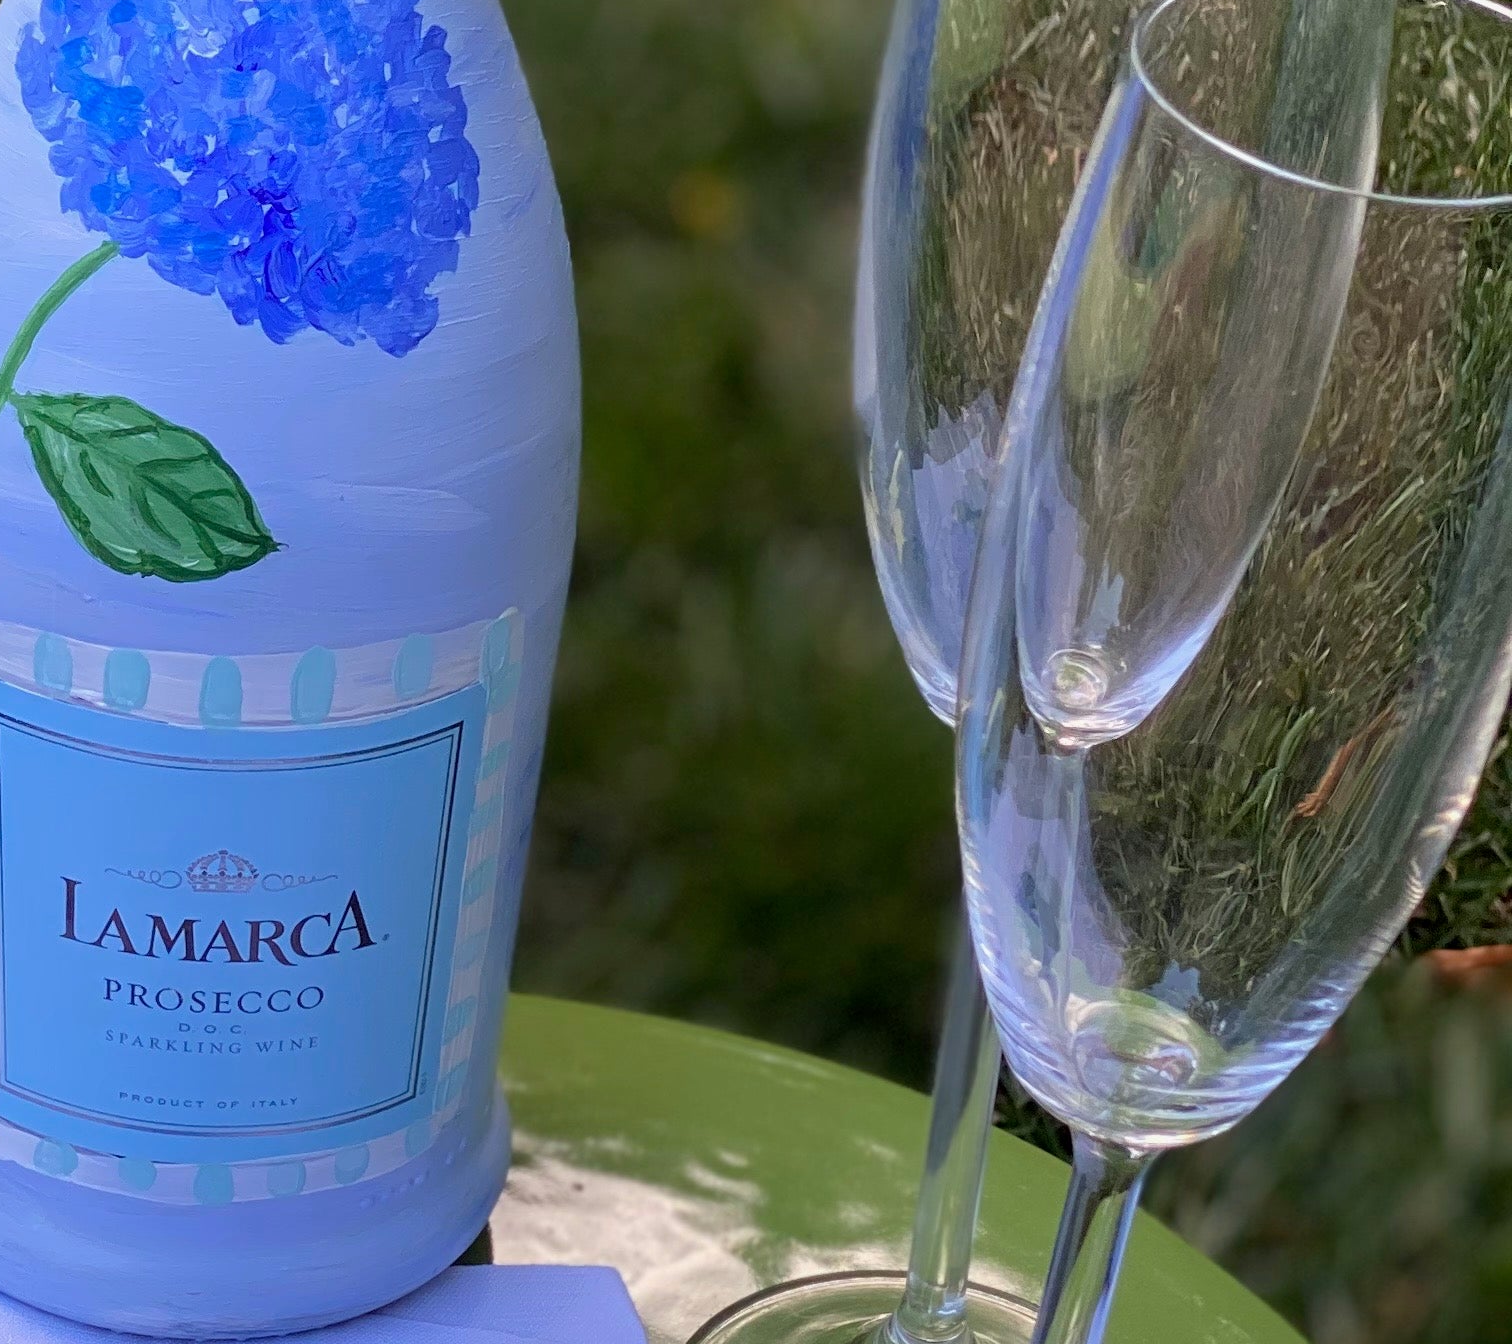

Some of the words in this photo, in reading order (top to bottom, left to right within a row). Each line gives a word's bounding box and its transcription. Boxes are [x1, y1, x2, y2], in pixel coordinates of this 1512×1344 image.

[103, 977, 324, 1014] PROSECCO
[105, 1029, 241, 1054] SPARKLING
[256, 1036, 319, 1053] WINE
[119, 1092, 204, 1109] PRODUCT
[217, 1101, 239, 1109] OF
[252, 1097, 298, 1108] ITALY
